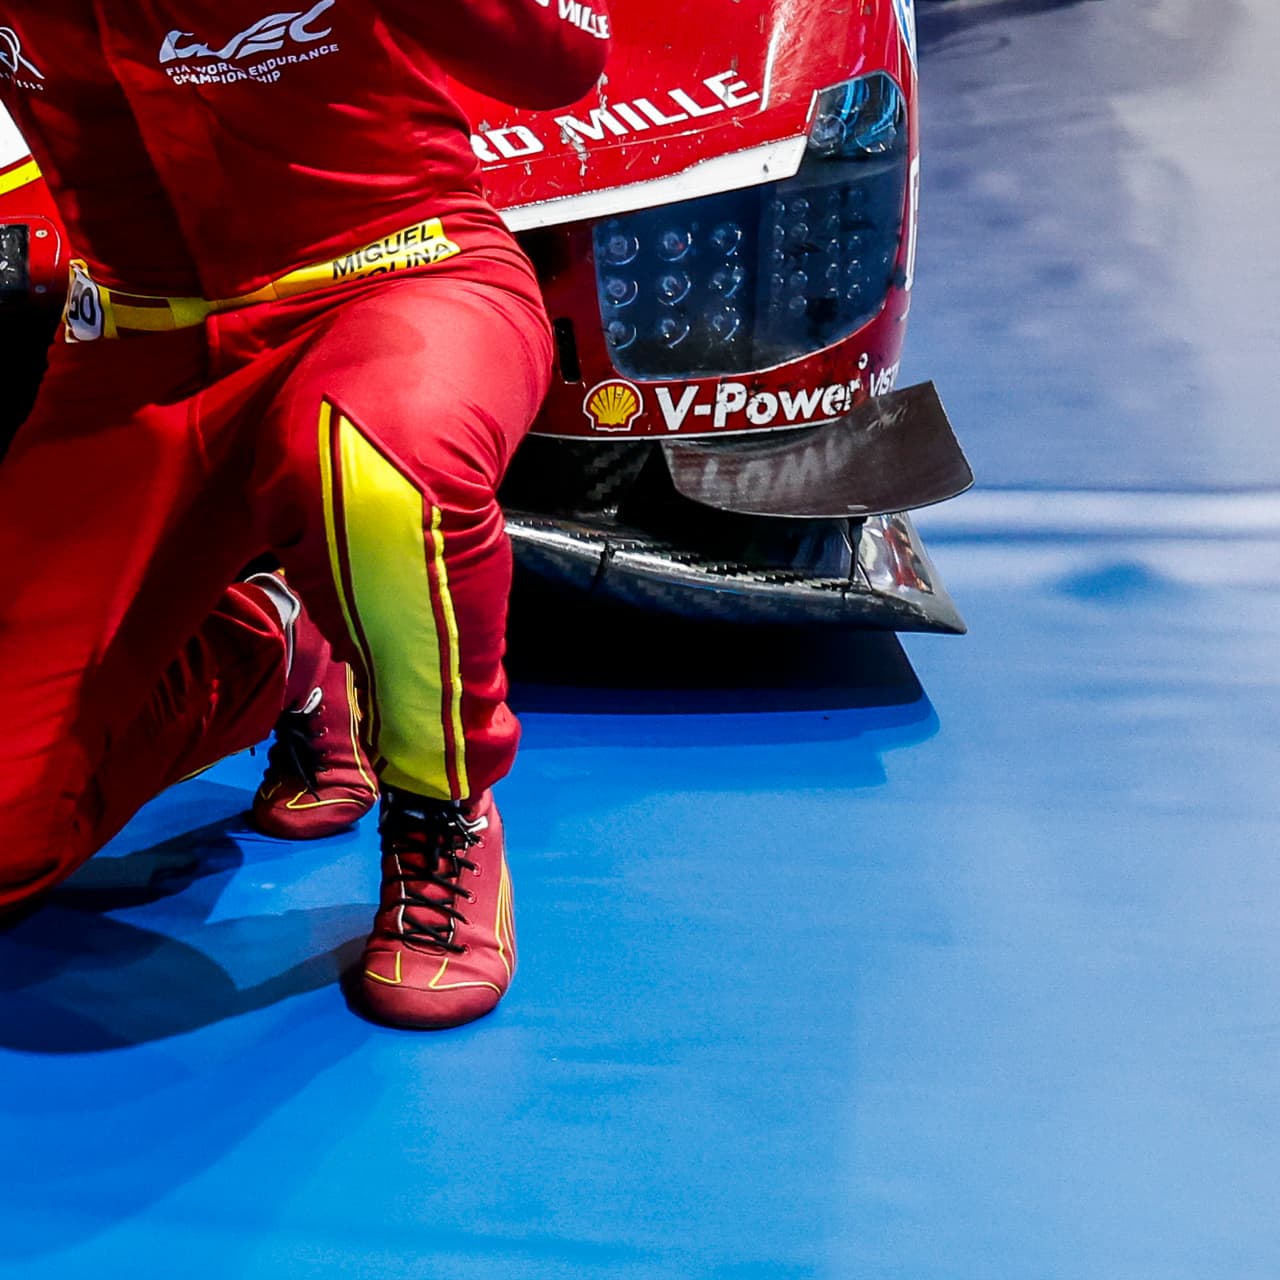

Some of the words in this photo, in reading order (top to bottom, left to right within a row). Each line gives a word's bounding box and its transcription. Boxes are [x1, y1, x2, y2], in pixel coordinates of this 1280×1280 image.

[166, 64, 190, 76] FIA
[248, 43, 339, 76] ENDURANCE
[553, 70, 760, 145] MILLE
[332, 224, 434, 280] MIGUEL
[655, 378, 861, 432] V-Power
